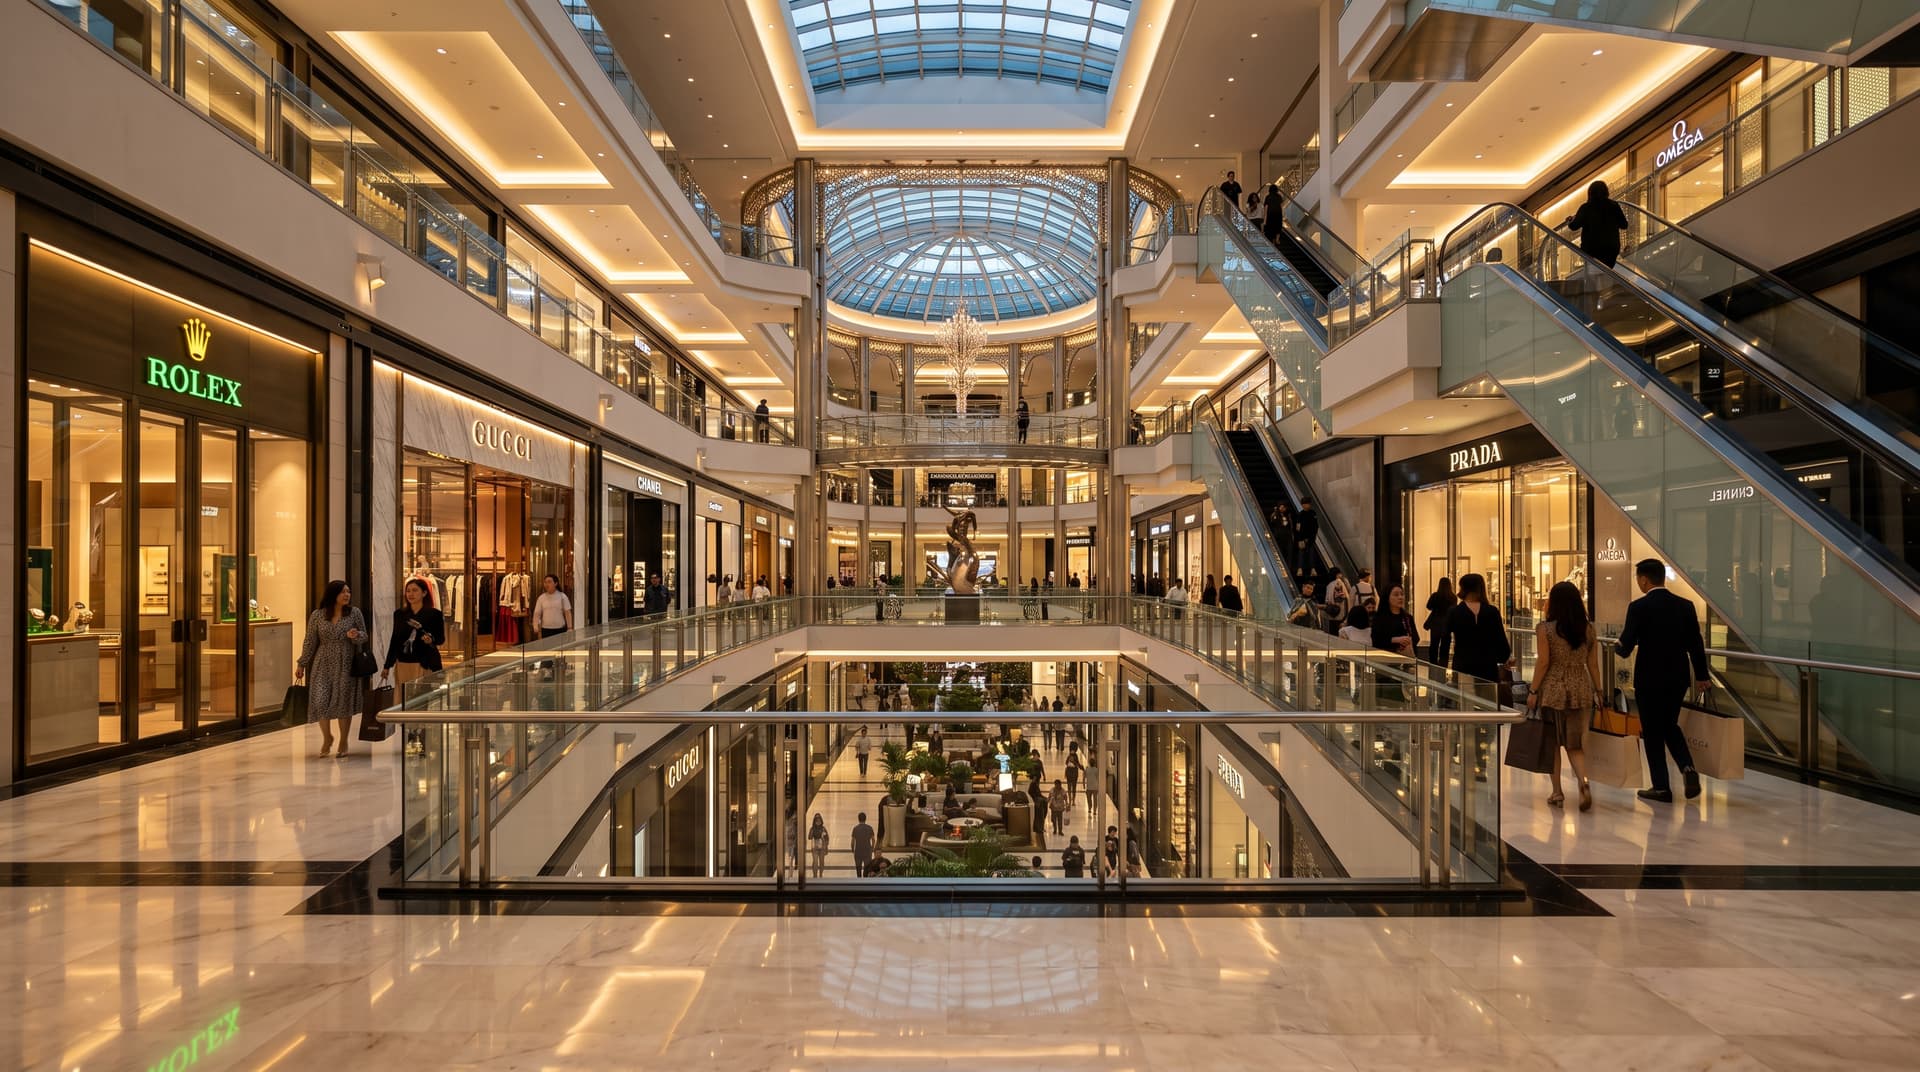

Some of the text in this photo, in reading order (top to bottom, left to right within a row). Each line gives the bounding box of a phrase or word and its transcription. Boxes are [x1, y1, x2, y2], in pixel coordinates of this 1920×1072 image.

[1656, 128, 1704, 168] OMEGA
[147, 356, 242, 407] ROLEX
[472, 420, 532, 461] GUCCI
[1449, 441, 1502, 473] PRADA
[637, 476, 663, 495] CHANEL
[1596, 550, 1626, 561] OMEGA
